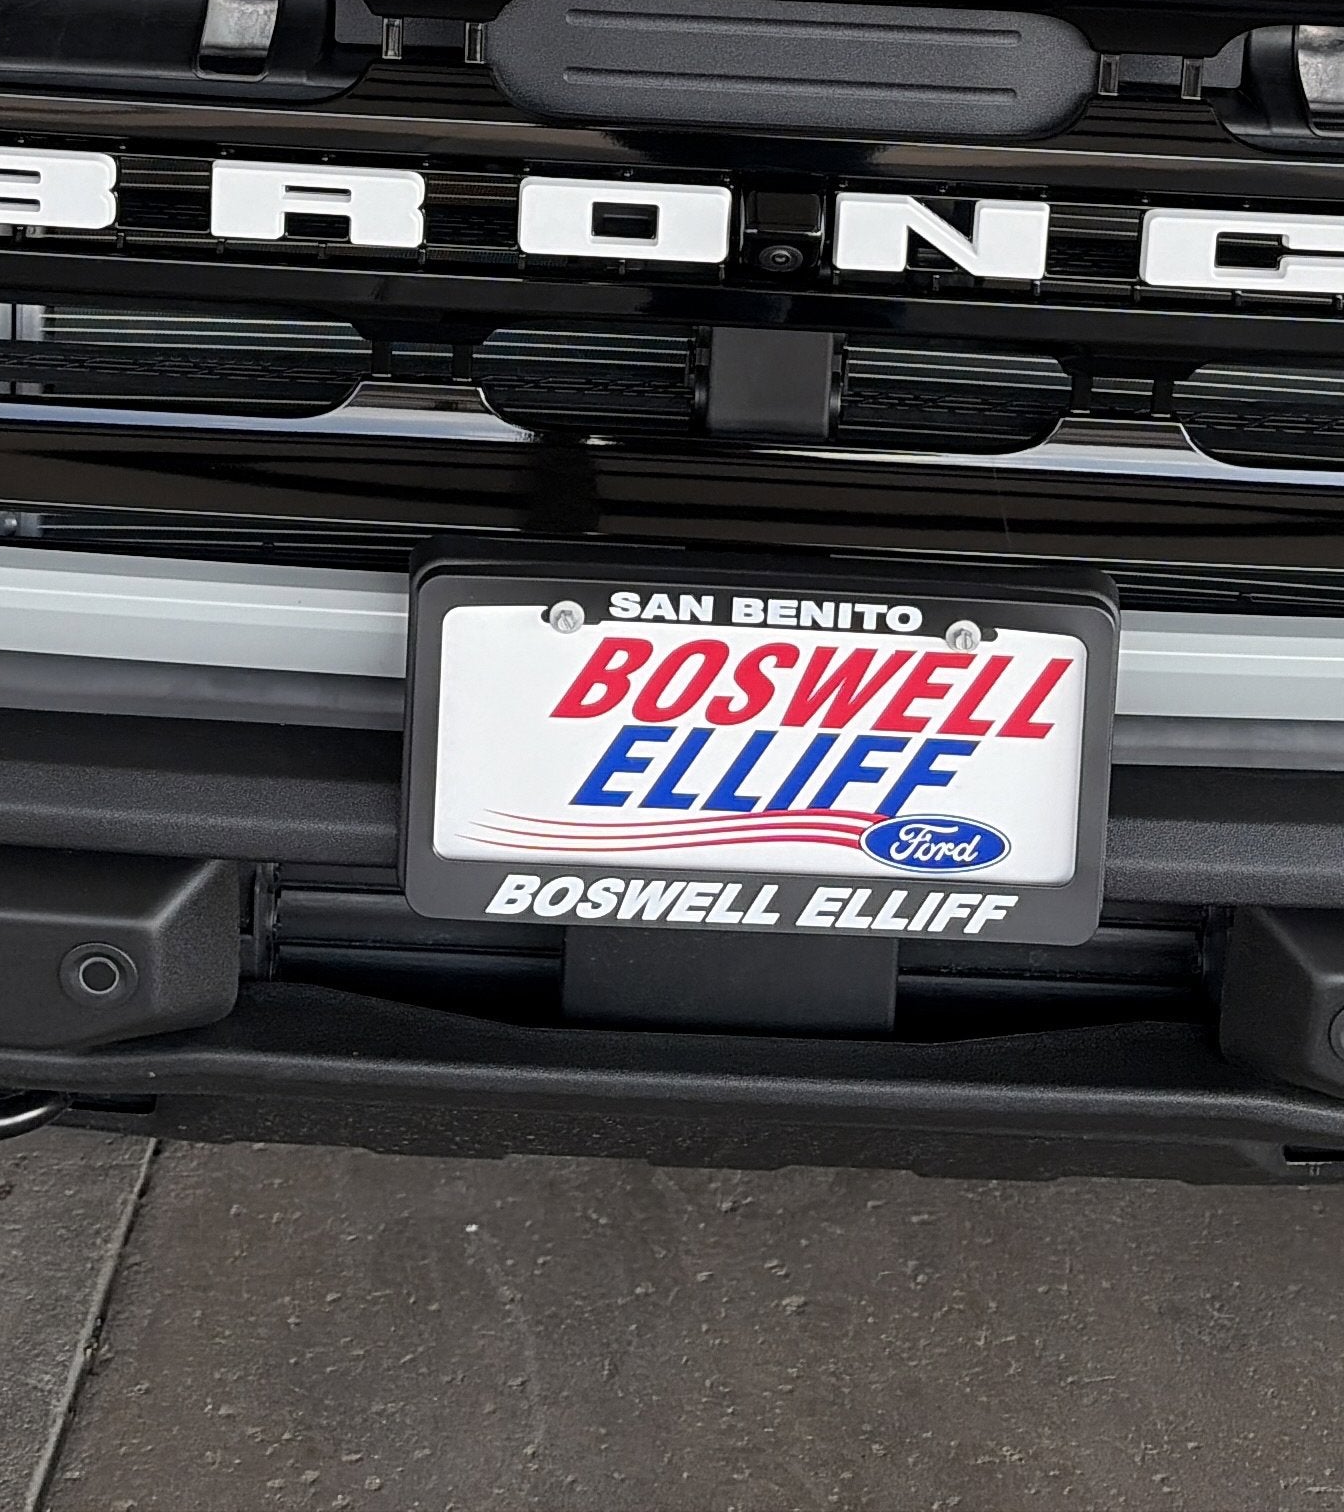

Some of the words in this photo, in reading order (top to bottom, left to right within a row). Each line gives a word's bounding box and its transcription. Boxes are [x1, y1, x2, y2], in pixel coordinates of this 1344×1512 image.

[609, 591, 716, 624] SAN
[730, 596, 924, 633] BENITO
[550, 636, 1073, 740] BOSWELL
[569, 724, 981, 816] ELLIFF
[889, 823, 982, 863] Ford
[484, 874, 780, 926] BOSWELL
[794, 886, 1019, 935] ELLIFF
